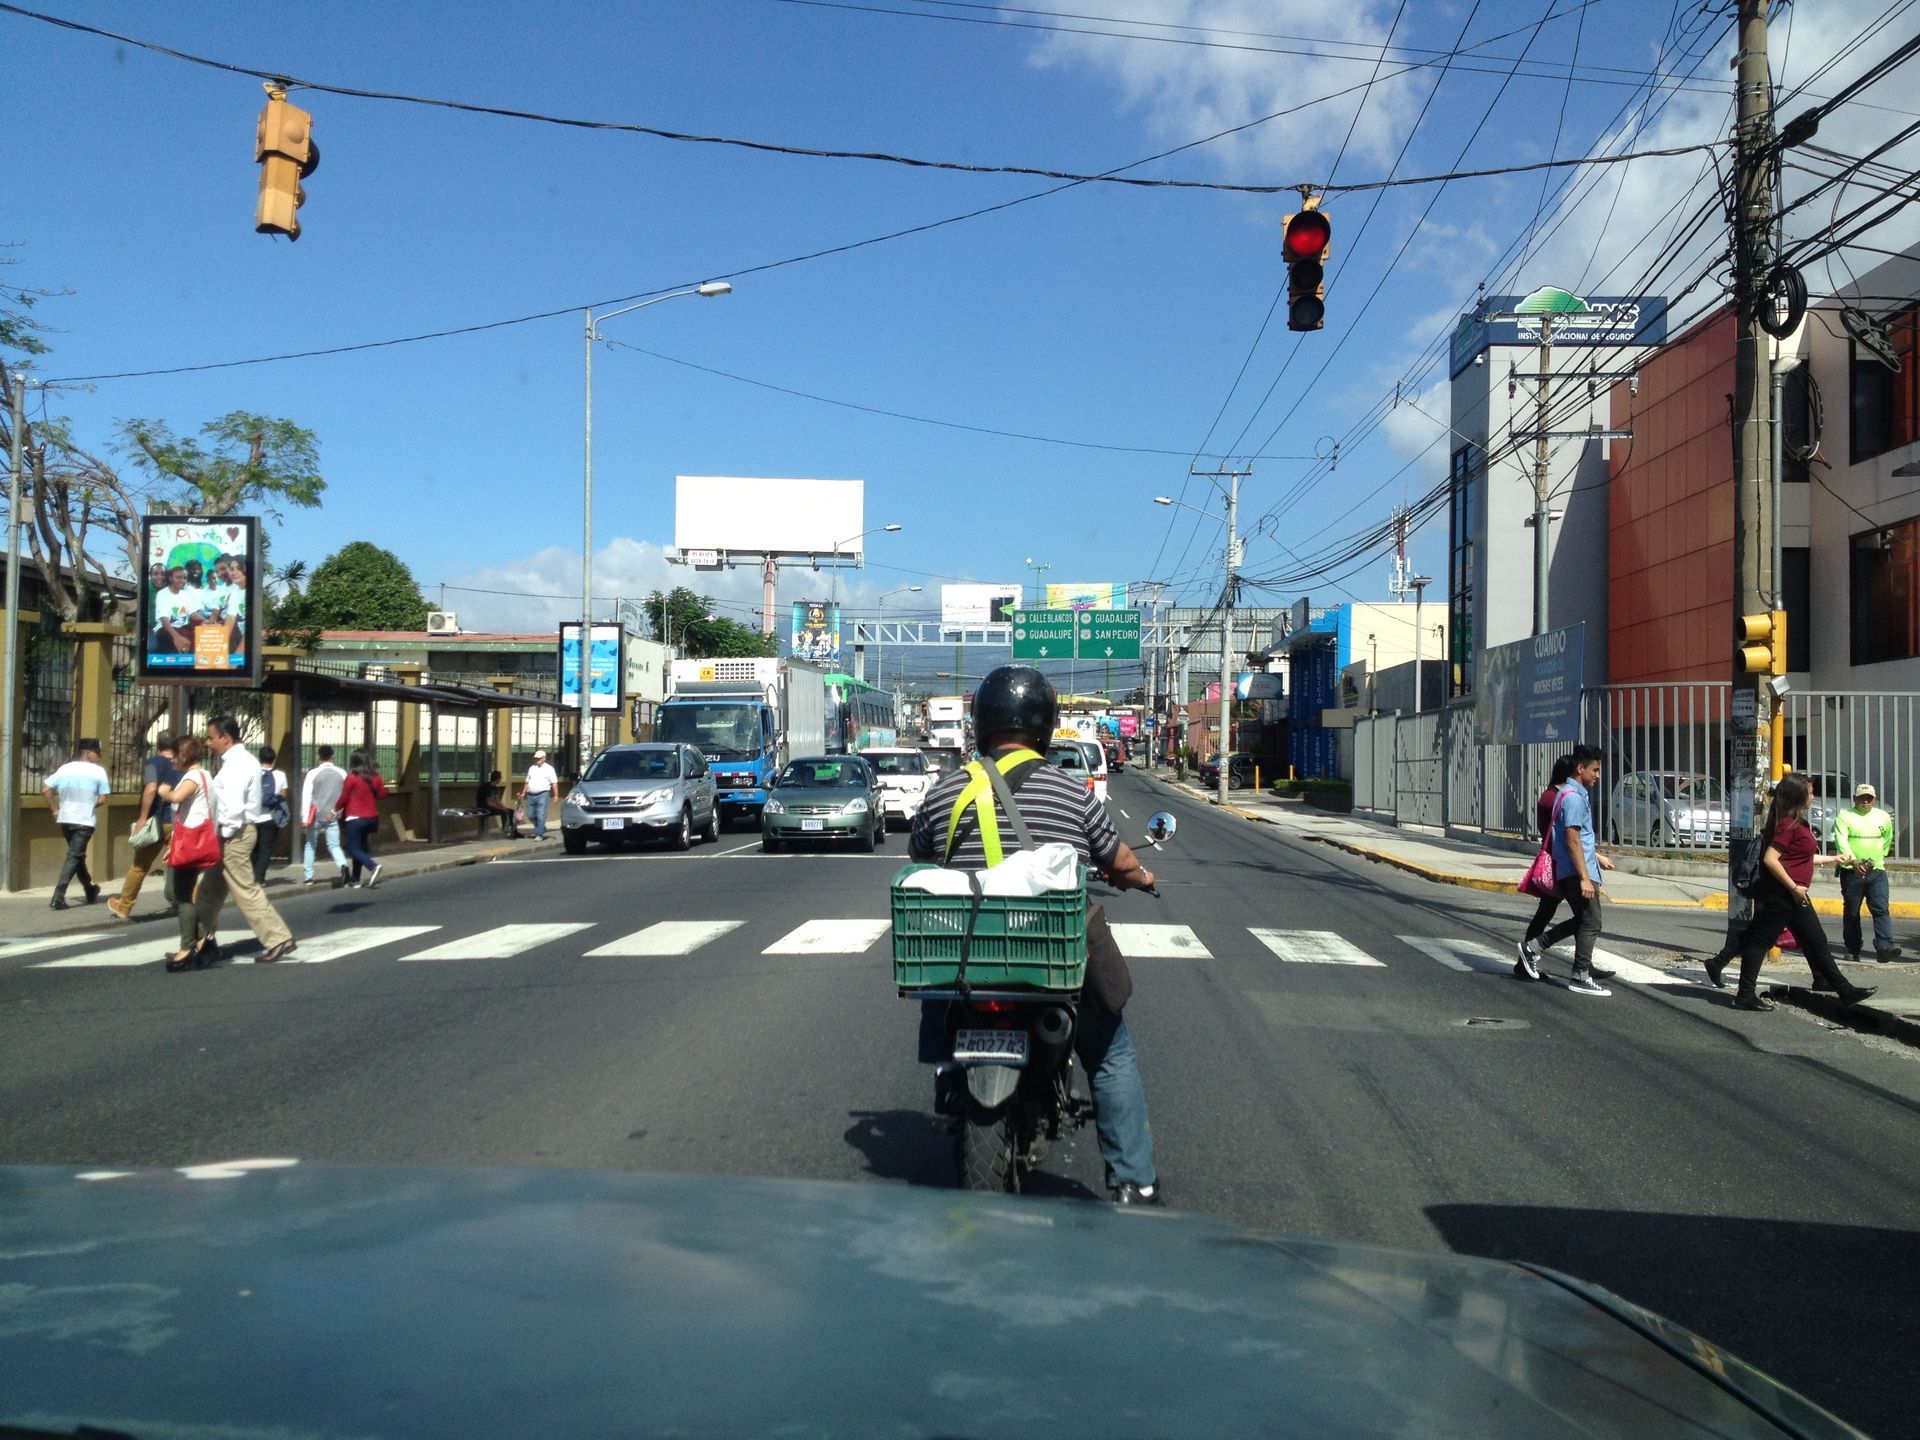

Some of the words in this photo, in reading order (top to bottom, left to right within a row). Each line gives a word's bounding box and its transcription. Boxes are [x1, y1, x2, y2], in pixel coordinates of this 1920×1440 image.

[1029, 613, 1047, 623] CALLE
[1048, 613, 1073, 623] BLANCOS
[1095, 613, 1139, 623] GUADALUPE
[1029, 629, 1073, 639] GUADALUPE
[1095, 629, 1111, 639] SAN
[1113, 629, 1138, 640] PEDRO
[1534, 630, 1566, 658] CUANDO
[967, 1038, 1025, 1054] 402743
